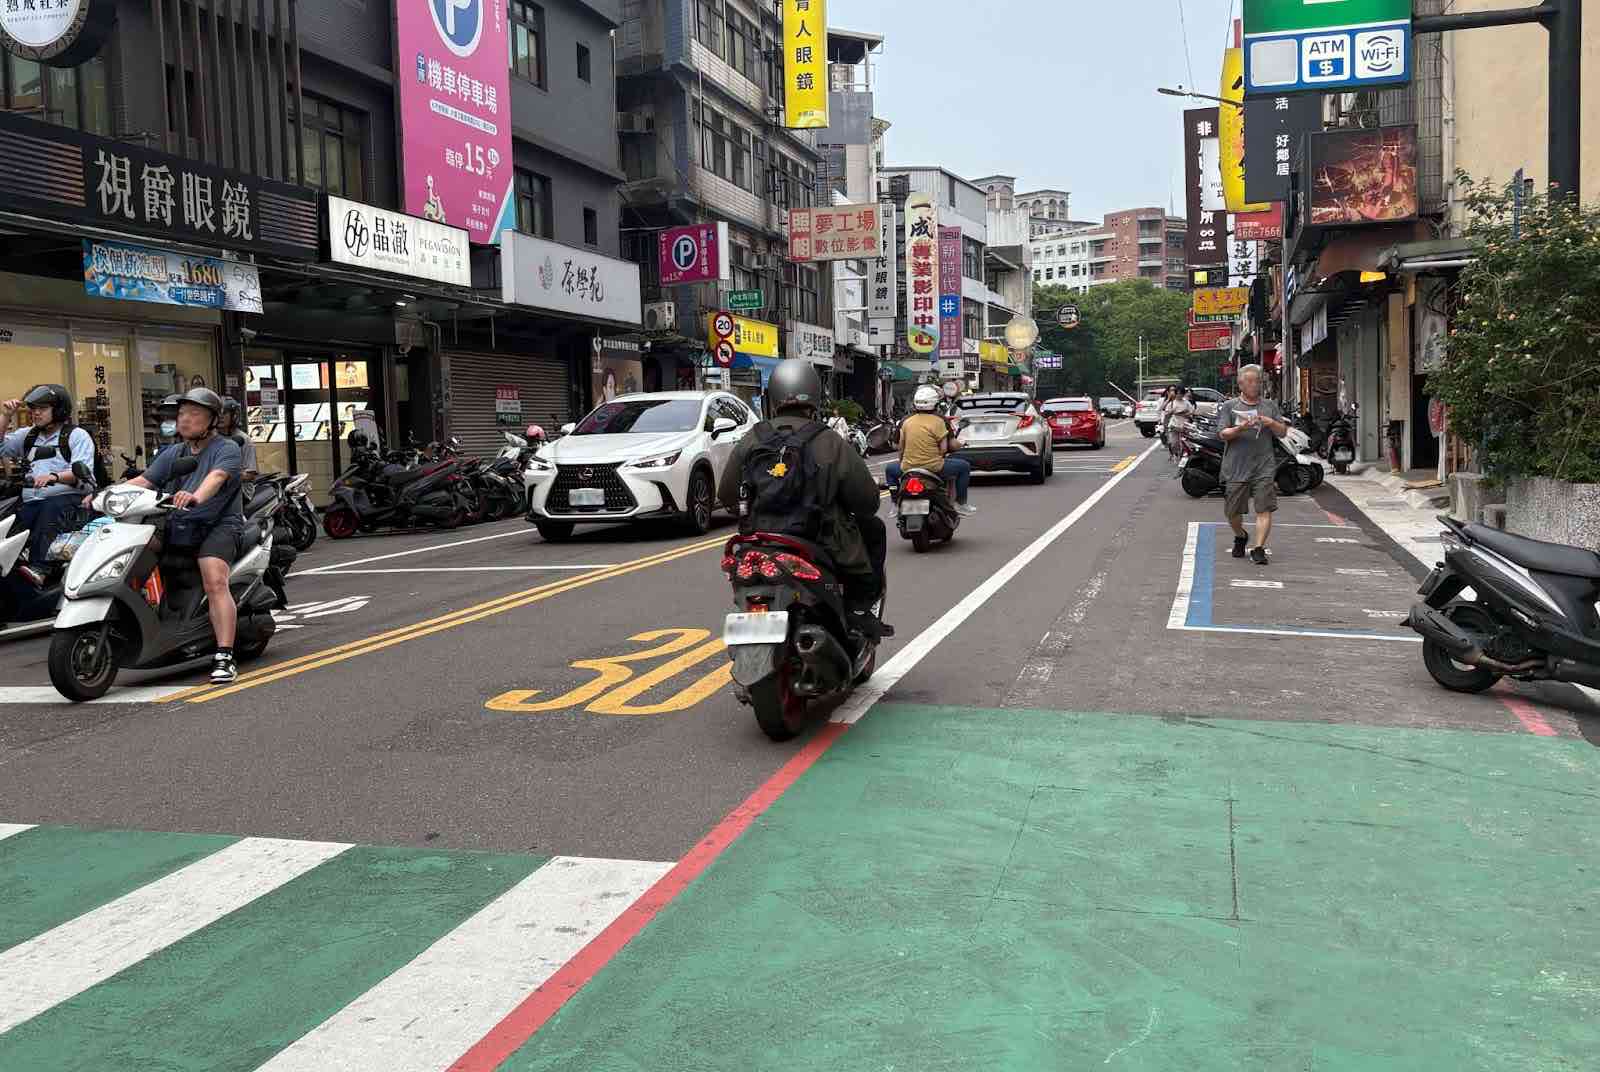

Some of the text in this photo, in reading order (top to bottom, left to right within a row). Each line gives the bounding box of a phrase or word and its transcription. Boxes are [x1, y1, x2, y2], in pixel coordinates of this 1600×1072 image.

[1309, 39, 1345, 55] ATM
[1361, 46, 1400, 62] Wi-Fi
[428, 58, 497, 115] 機車停車場
[94, 149, 253, 241] 視爵眼鏡
[815, 209, 875, 234] 夢工場
[183, 259, 224, 286] 1680
[717, 320, 730, 330] 20
